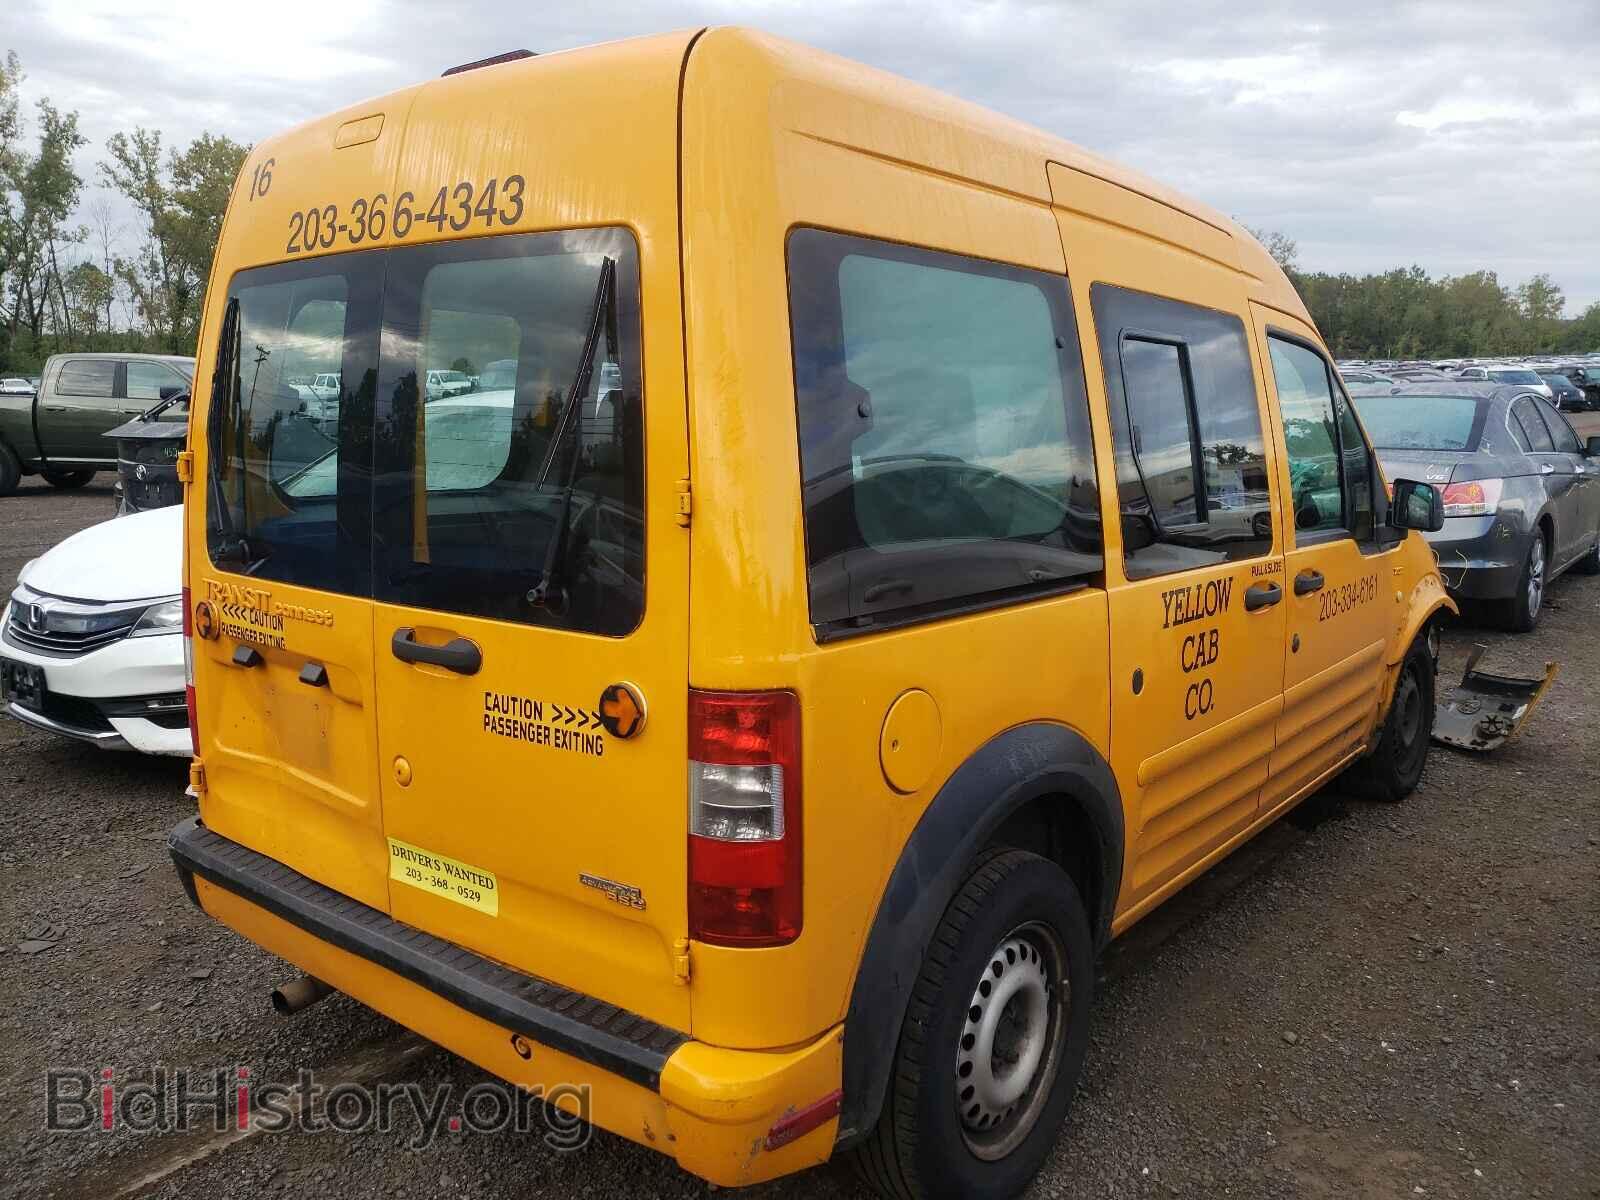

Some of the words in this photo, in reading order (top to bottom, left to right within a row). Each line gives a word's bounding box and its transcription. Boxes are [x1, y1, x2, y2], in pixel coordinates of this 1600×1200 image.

[249, 157, 275, 202] 16
[286, 174, 526, 254] 203-366-4343
[201, 577, 272, 613] TRANSIT
[1161, 576, 1234, 629] YELLOW
[221, 621, 257, 645] PASSENGER
[249, 608, 284, 632] CAUTION
[1181, 628, 1219, 673] CAB
[484, 691, 543, 721] CAUTION
[1184, 678, 1214, 720] CO.
[483, 713, 551, 746] PASSENGER
[554, 727, 604, 756] EXITING
[391, 844, 441, 872] DRIVER'S
[443, 862, 494, 890] WANTED
